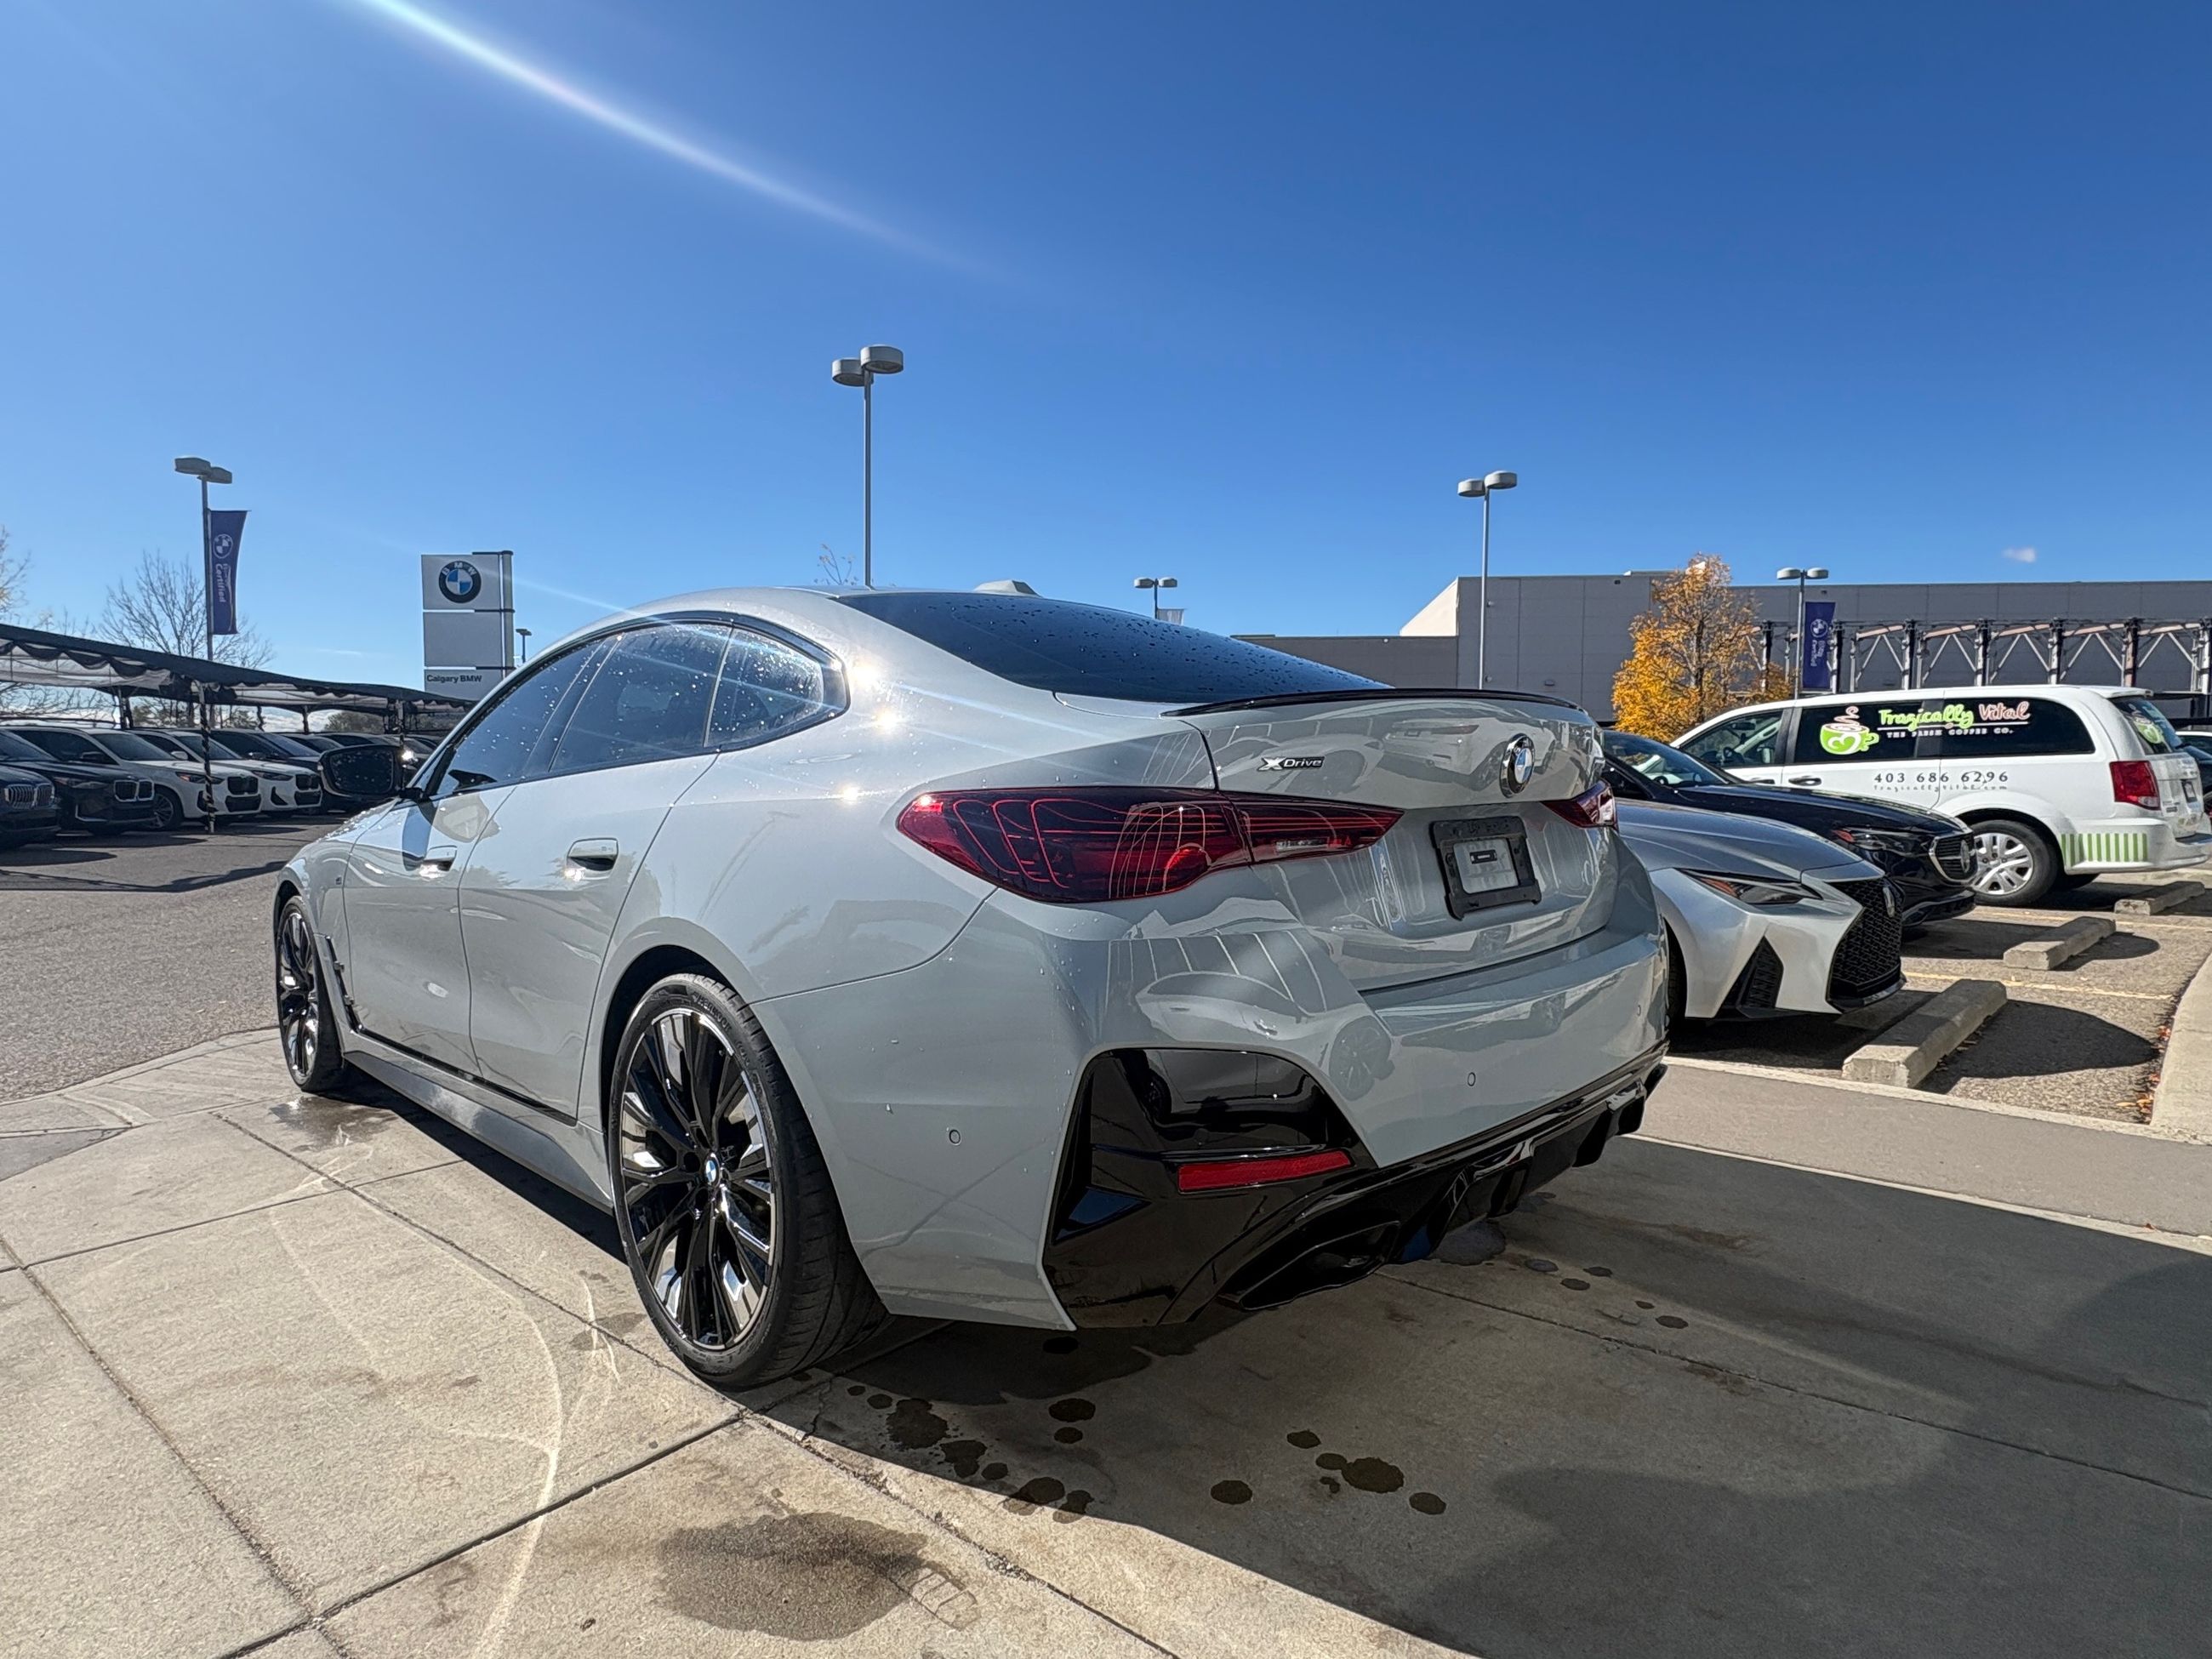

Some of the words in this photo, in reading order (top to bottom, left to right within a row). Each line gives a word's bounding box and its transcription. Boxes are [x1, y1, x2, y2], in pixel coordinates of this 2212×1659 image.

[441, 561, 477, 576] BMW
[426, 675, 459, 684] Calgary
[1878, 704, 1975, 732] Tragically
[1978, 701, 2032, 721] Vital
[1911, 729, 1943, 738] FRESH
[1947, 727, 1988, 736] COFFEE
[1874, 772, 1905, 783] 403
[1916, 772, 1949, 783] 686
[1960, 771, 2009, 783] 6296
